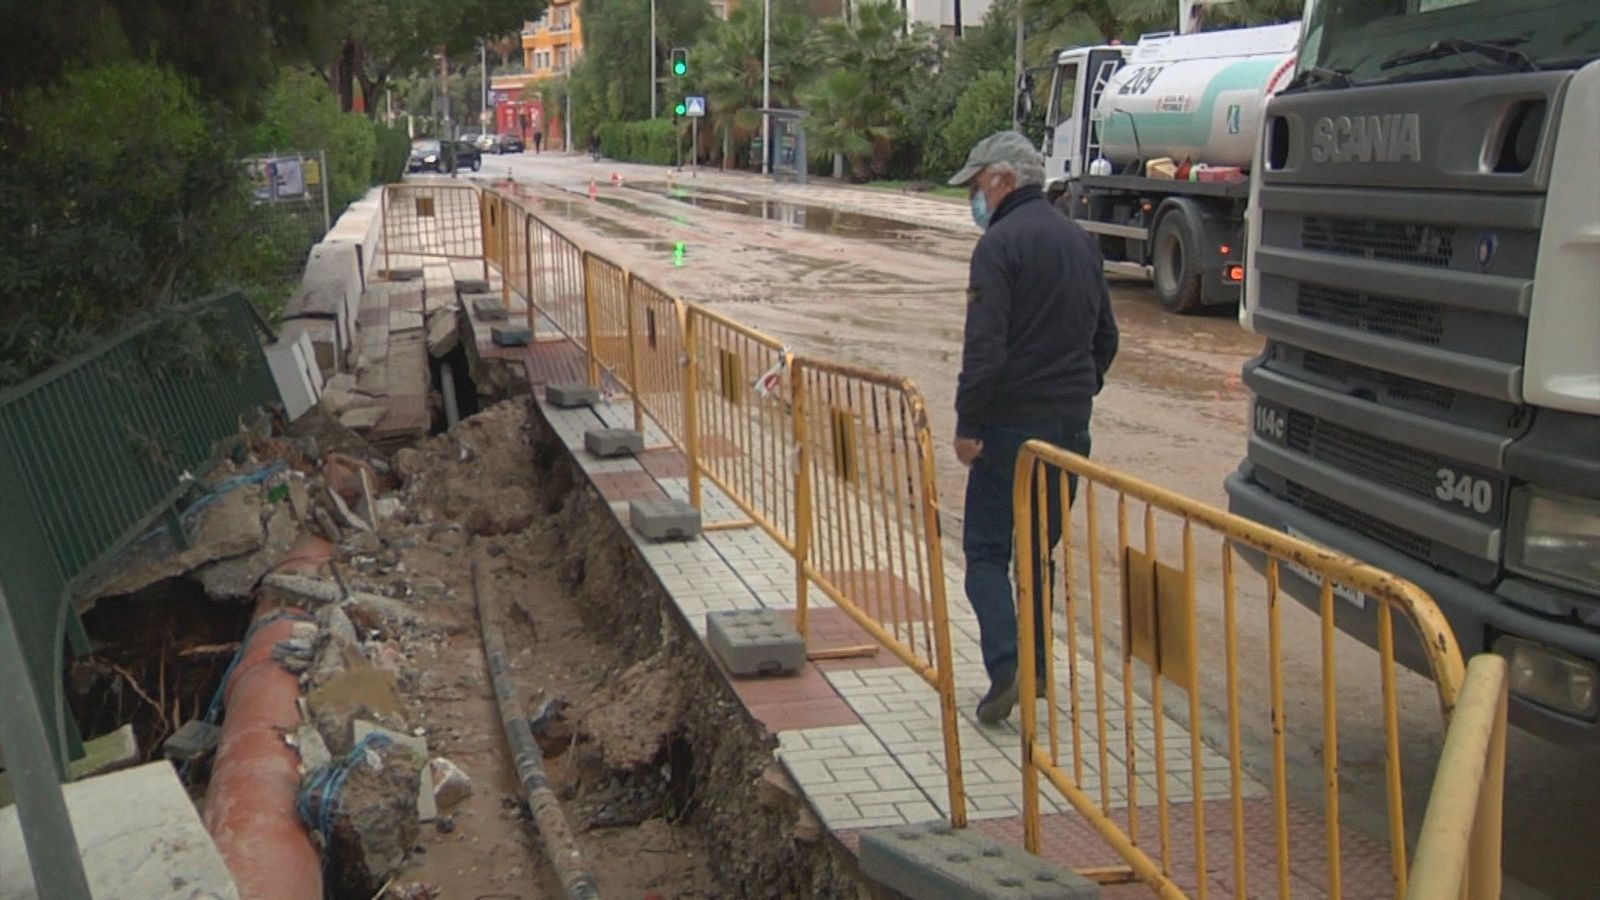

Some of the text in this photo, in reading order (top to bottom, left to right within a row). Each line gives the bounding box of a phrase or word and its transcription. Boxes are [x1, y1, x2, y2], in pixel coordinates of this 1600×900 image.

[1118, 66, 1164, 95] 209
[1311, 113, 1421, 163] SCANIA
[1435, 467, 1493, 513] 340
